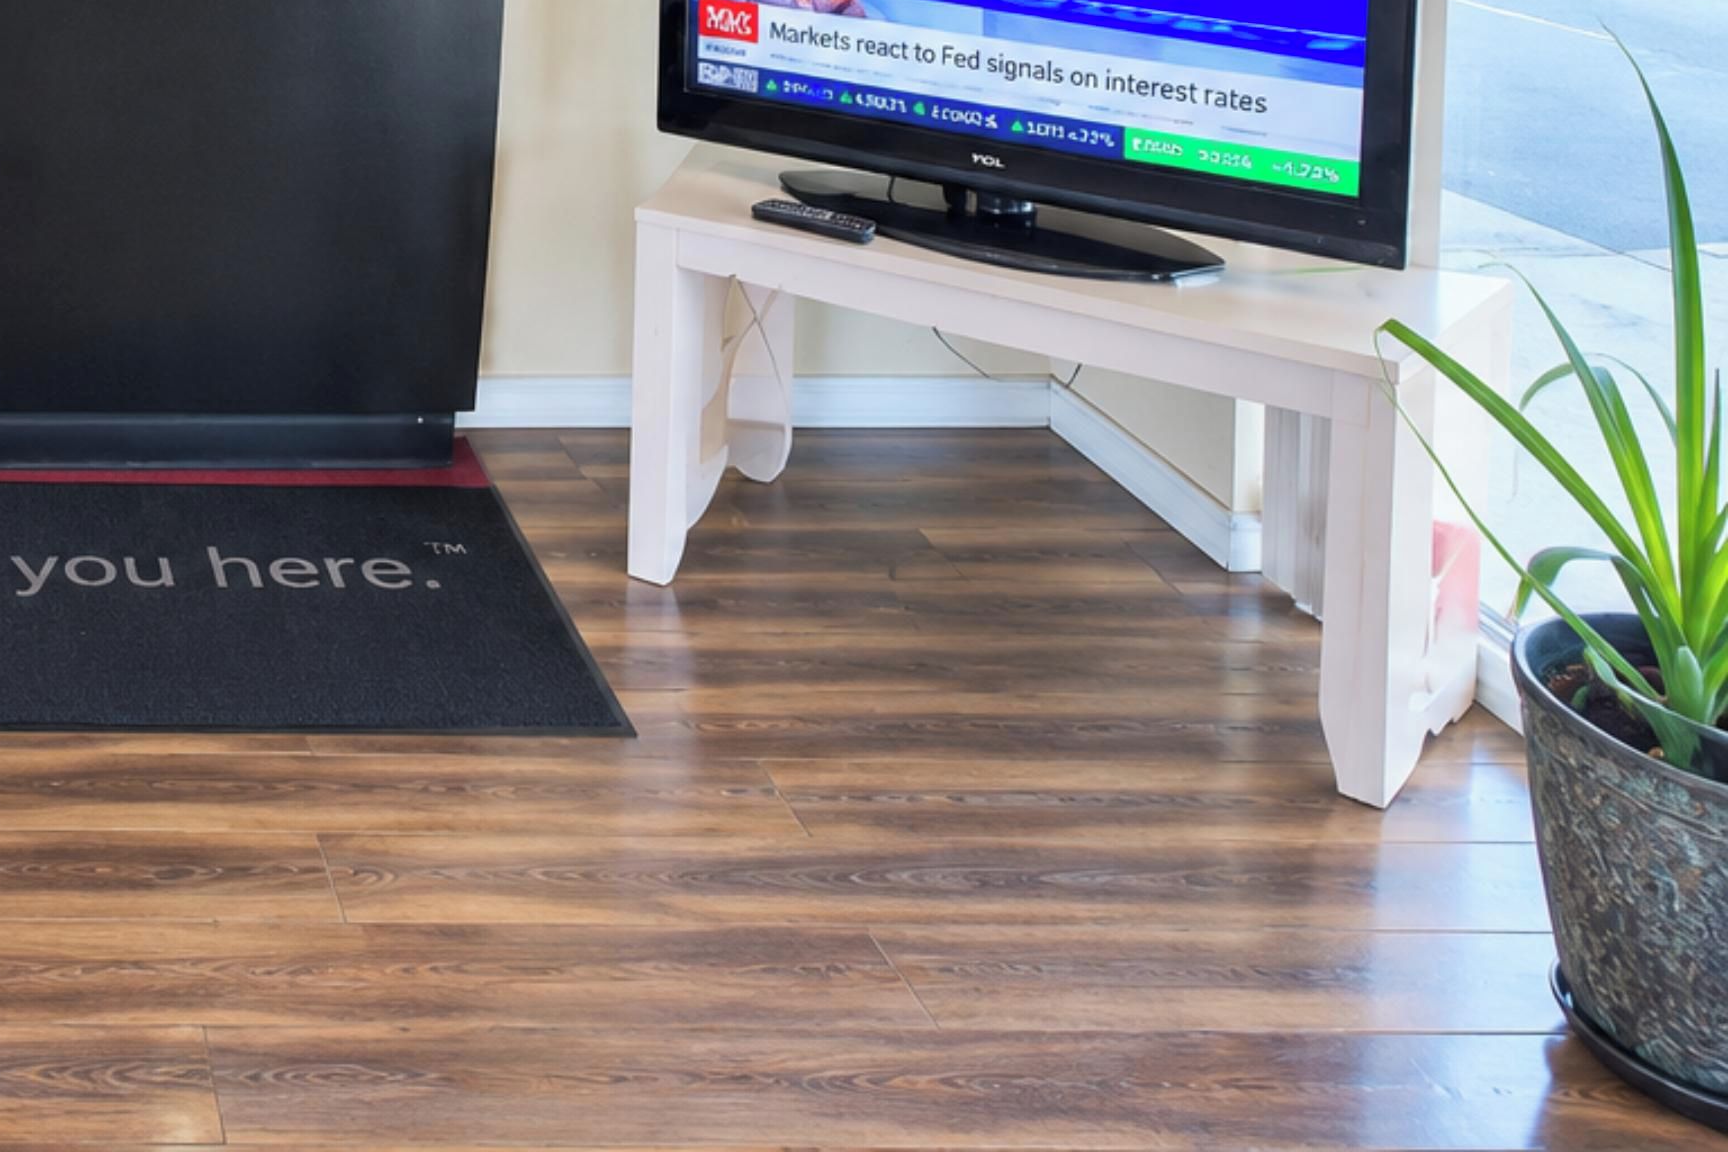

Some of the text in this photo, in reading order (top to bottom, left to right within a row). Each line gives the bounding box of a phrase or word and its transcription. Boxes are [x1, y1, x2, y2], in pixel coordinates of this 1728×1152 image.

[768, 21, 852, 51] Markets
[856, 37, 909, 62] react
[914, 42, 937, 65] to
[941, 44, 980, 71] Fed
[986, 52, 1065, 84] signals
[1070, 69, 1099, 89] on
[1105, 68, 1199, 105] interest
[1203, 86, 1269, 114] rates
[9, 554, 177, 598] you
